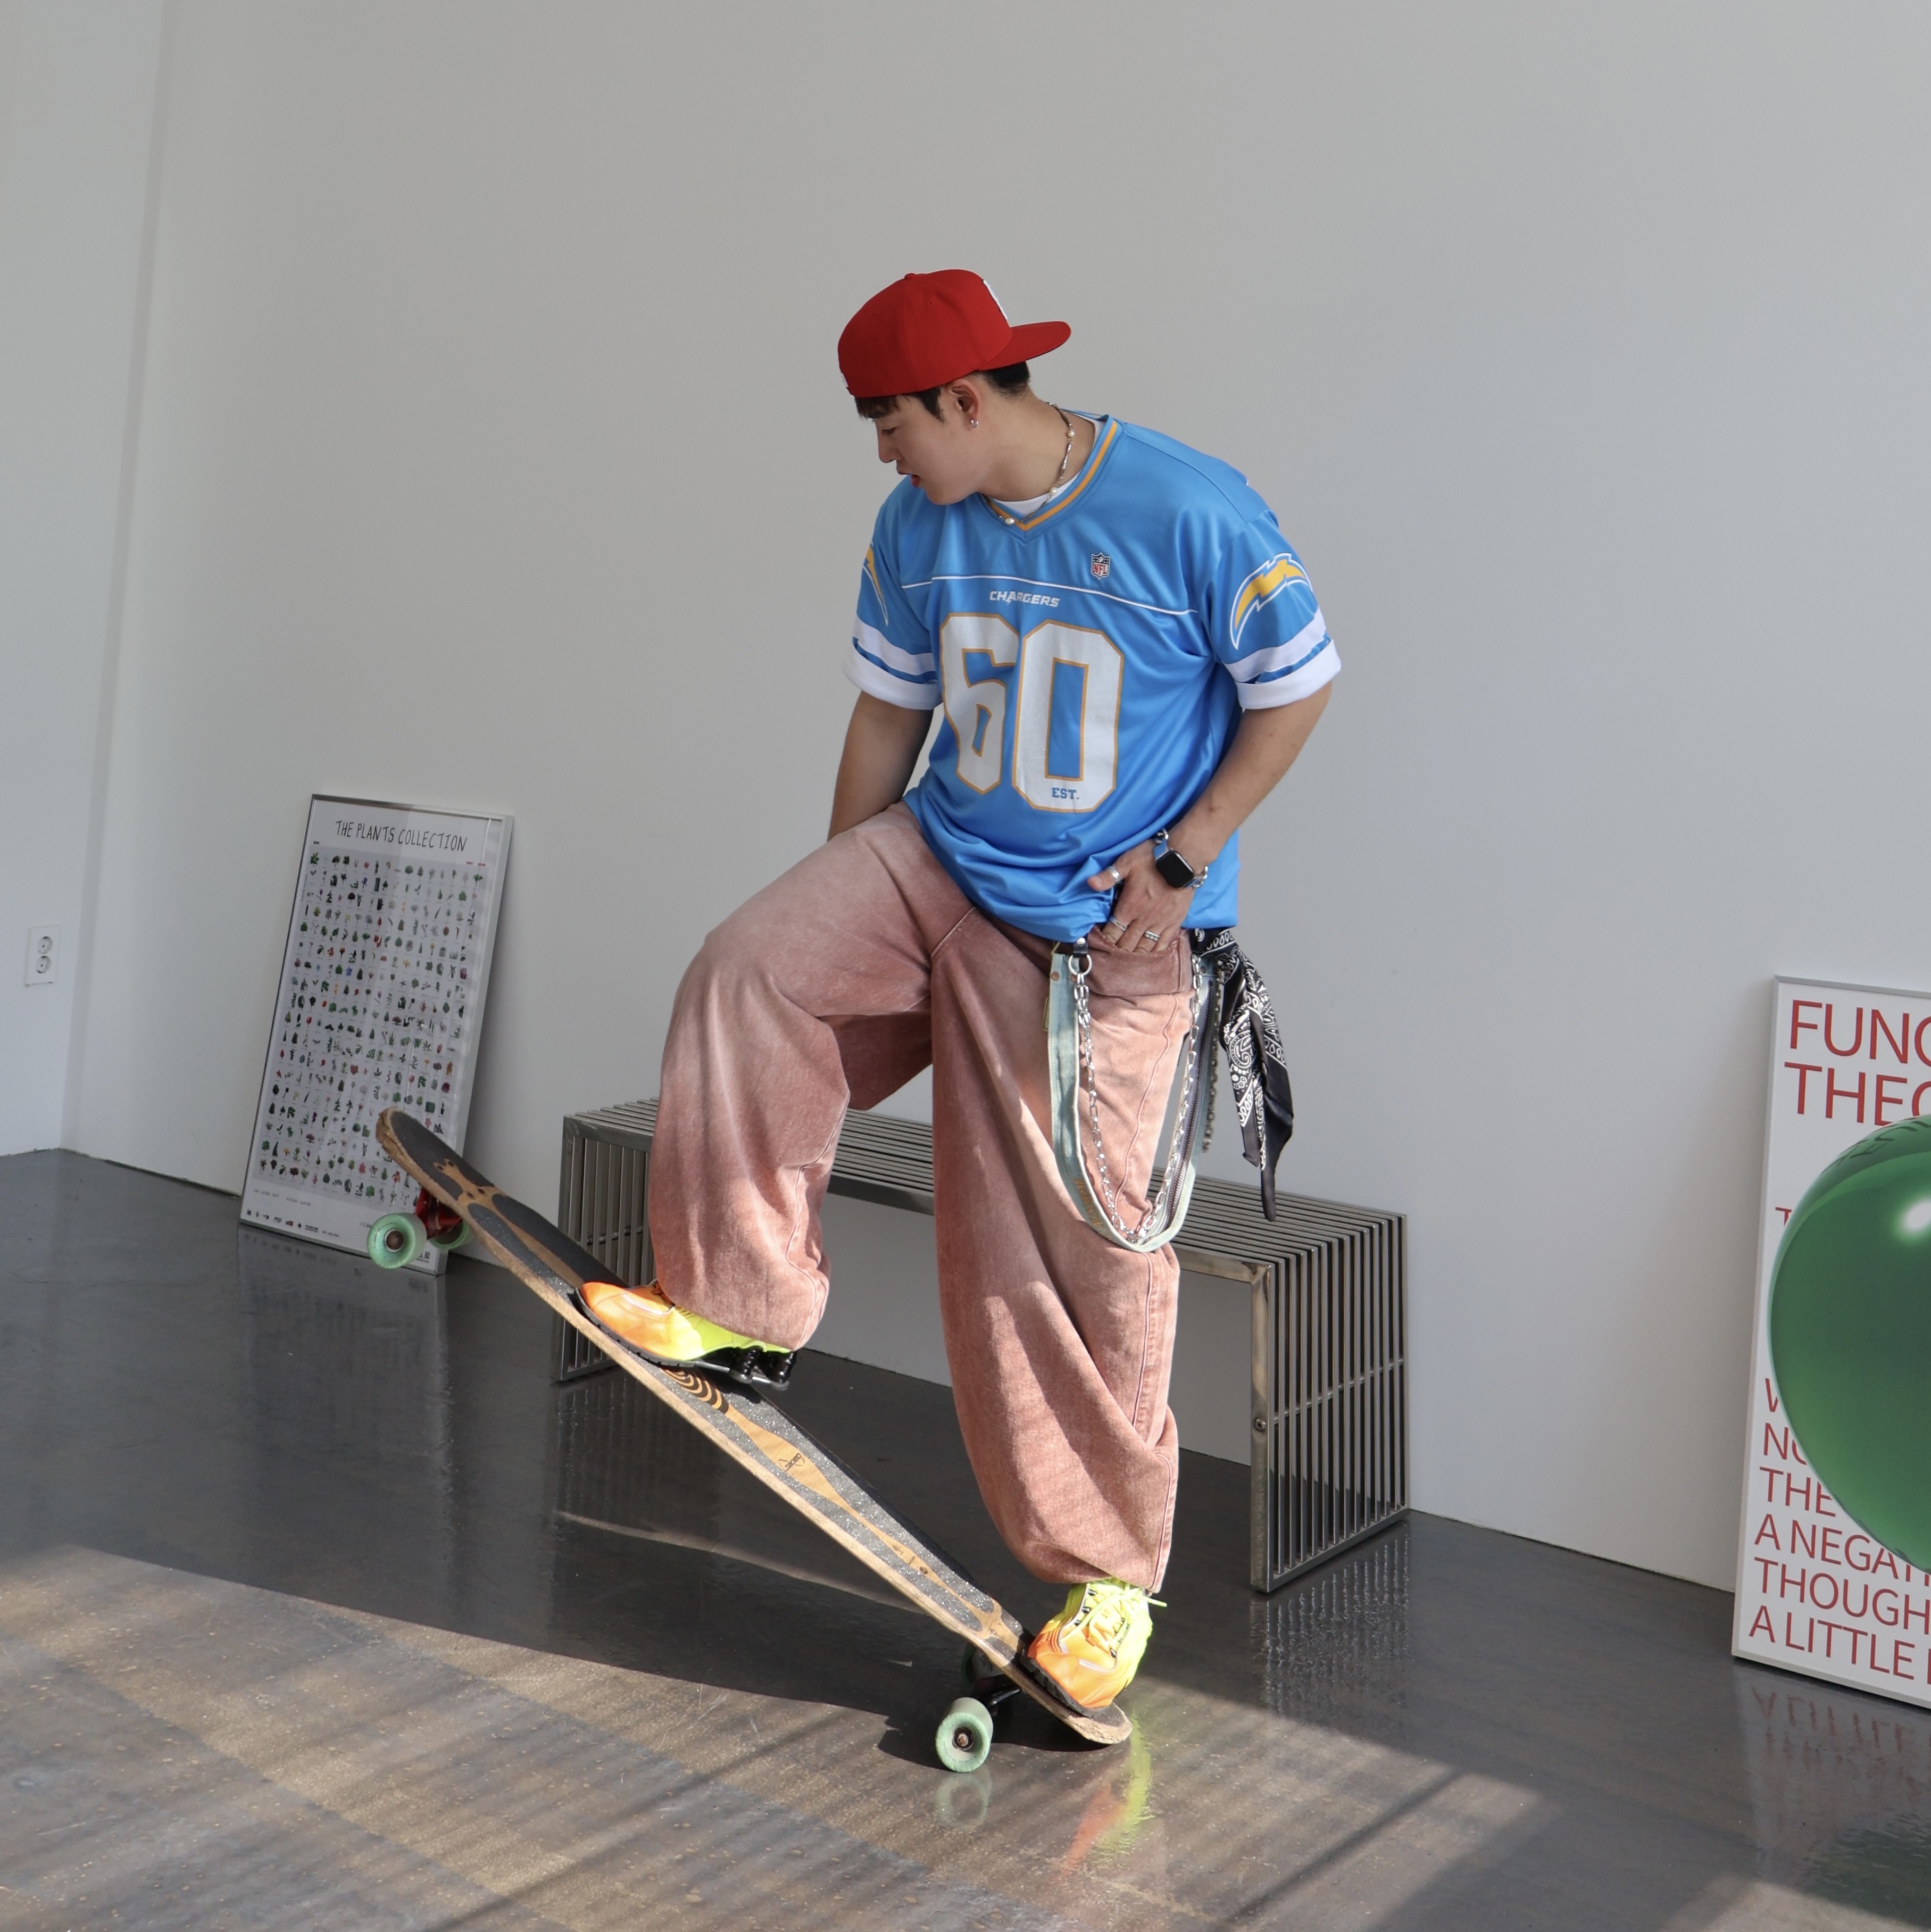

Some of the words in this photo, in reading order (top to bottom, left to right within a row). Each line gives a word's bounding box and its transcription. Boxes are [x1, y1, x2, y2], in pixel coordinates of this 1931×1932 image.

[1093, 563, 1108, 575] NFL
[989, 590, 1060, 607] CHARGERS
[940, 612, 1123, 812] 60
[1052, 787, 1079, 800] EST.
[336, 820, 353, 838] THE
[356, 823, 395, 843] PLANTS
[398, 828, 468, 852] COLLECTION
[1754, 1513, 1781, 1551] A
[1754, 1556, 1931, 1635] THOUGH
[1749, 1605, 1776, 1643] A
[1786, 1612, 1916, 1680] LITTLE
